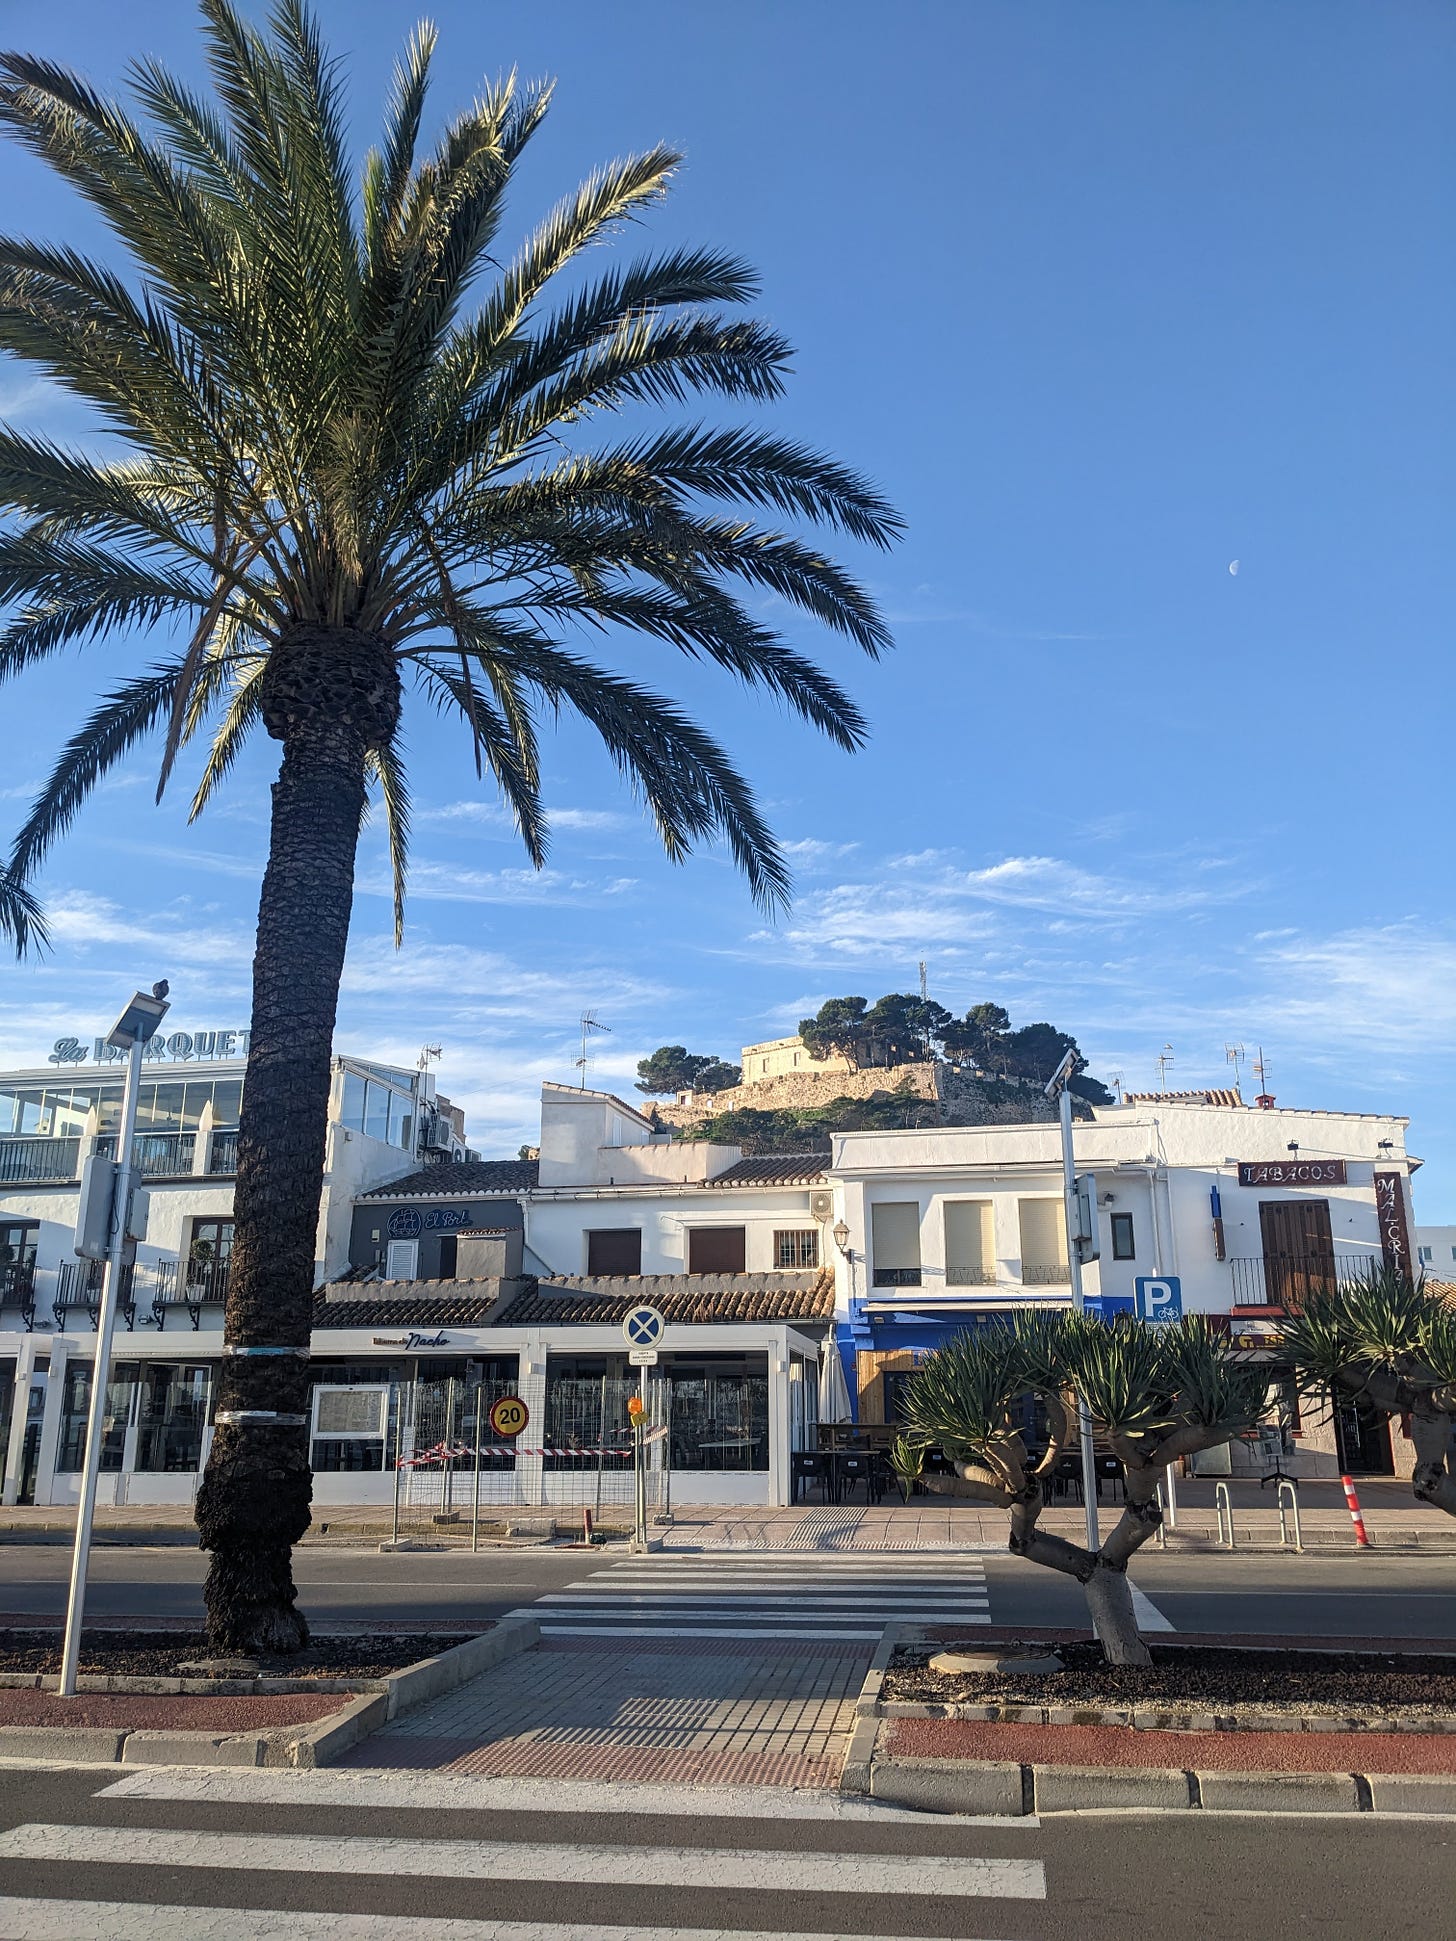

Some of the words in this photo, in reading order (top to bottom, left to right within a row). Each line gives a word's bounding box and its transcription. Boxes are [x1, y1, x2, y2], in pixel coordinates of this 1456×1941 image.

[48, 1037, 90, 1063] La
[1243, 1164, 1337, 1184] TABACOS
[425, 1211, 441, 1229] El
[1143, 1281, 1172, 1317] P
[405, 1330, 451, 1351] Nacho
[500, 1407, 521, 1425] 20
